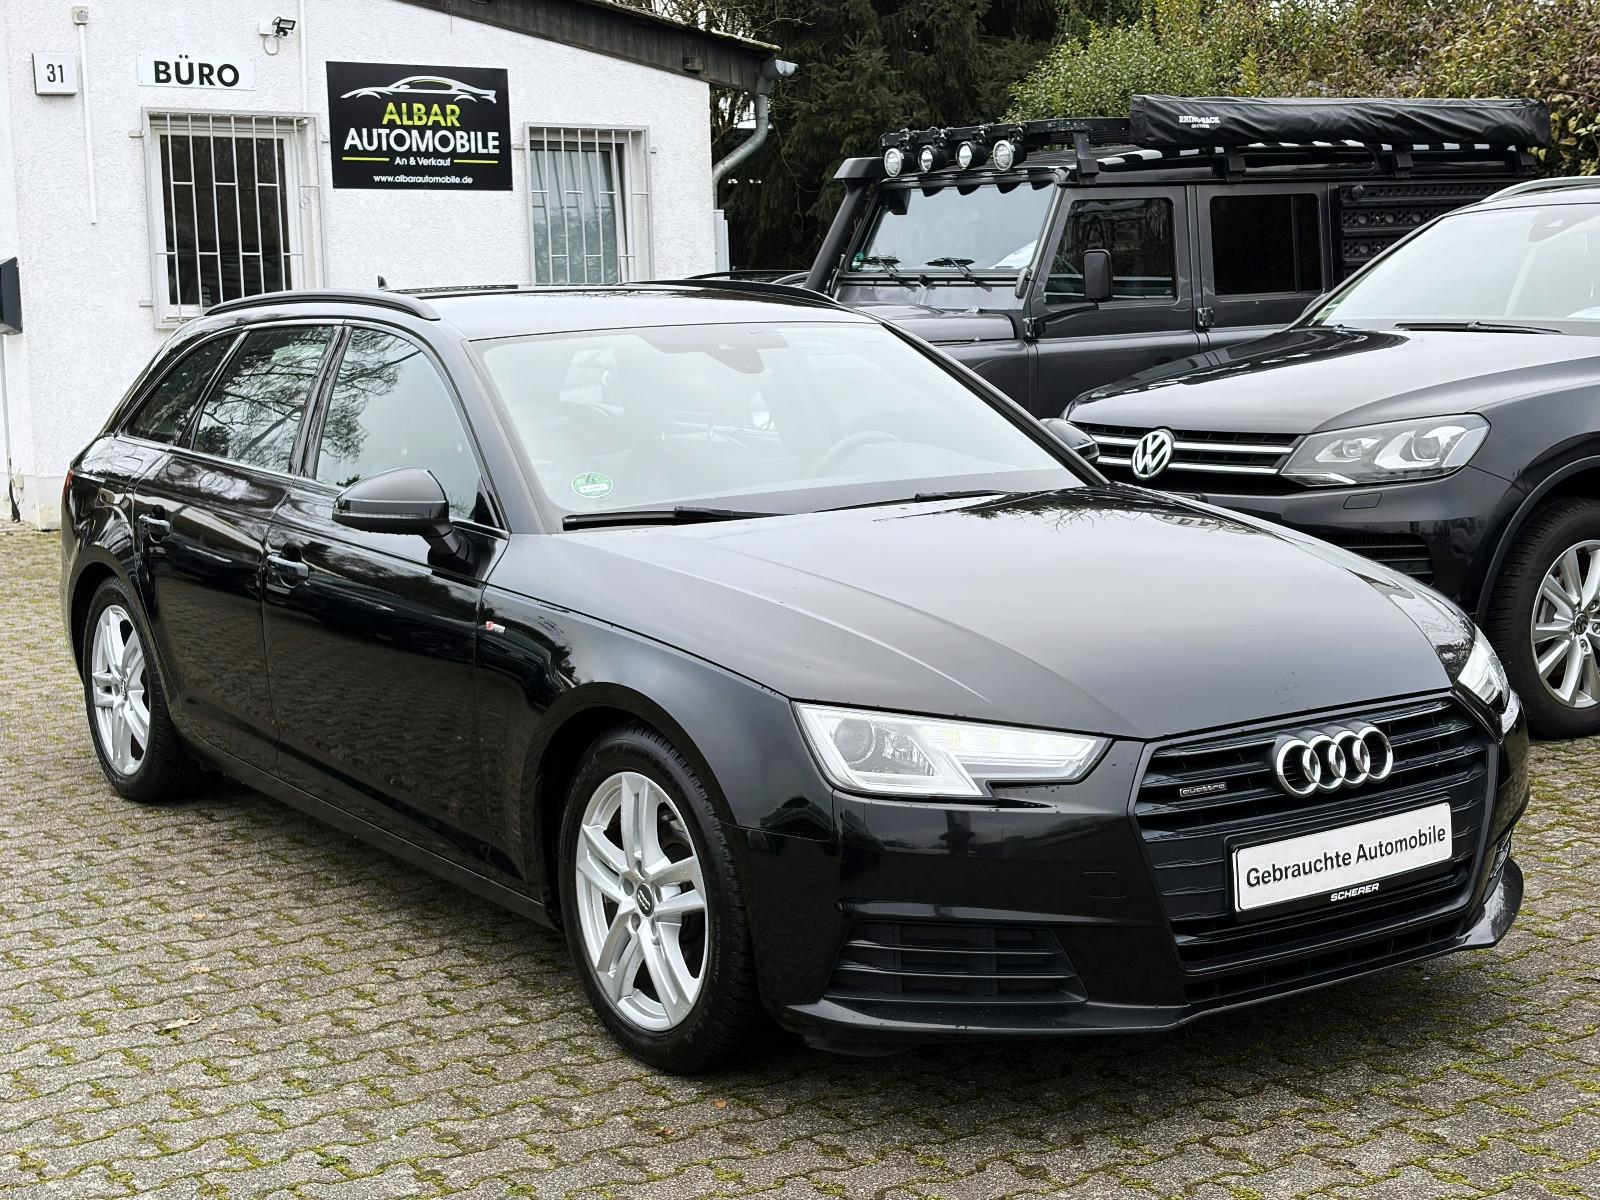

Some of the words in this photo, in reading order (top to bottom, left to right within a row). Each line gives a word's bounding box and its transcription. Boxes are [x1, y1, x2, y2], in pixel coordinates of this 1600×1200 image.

[46, 63, 64, 83] 31
[153, 54, 240, 87] BÜRO
[381, 102, 461, 127] ALBAR
[343, 127, 500, 154] AUTOMOBILE
[394, 156, 407, 166] An
[409, 156, 416, 166] &
[417, 156, 451, 166] Verkauf
[373, 174, 474, 184] www.albarautomobile.de
[1246, 850, 1352, 888] Gebrauchte
[1355, 824, 1446, 864] Automobile
[1330, 882, 1380, 902] SCHERER
